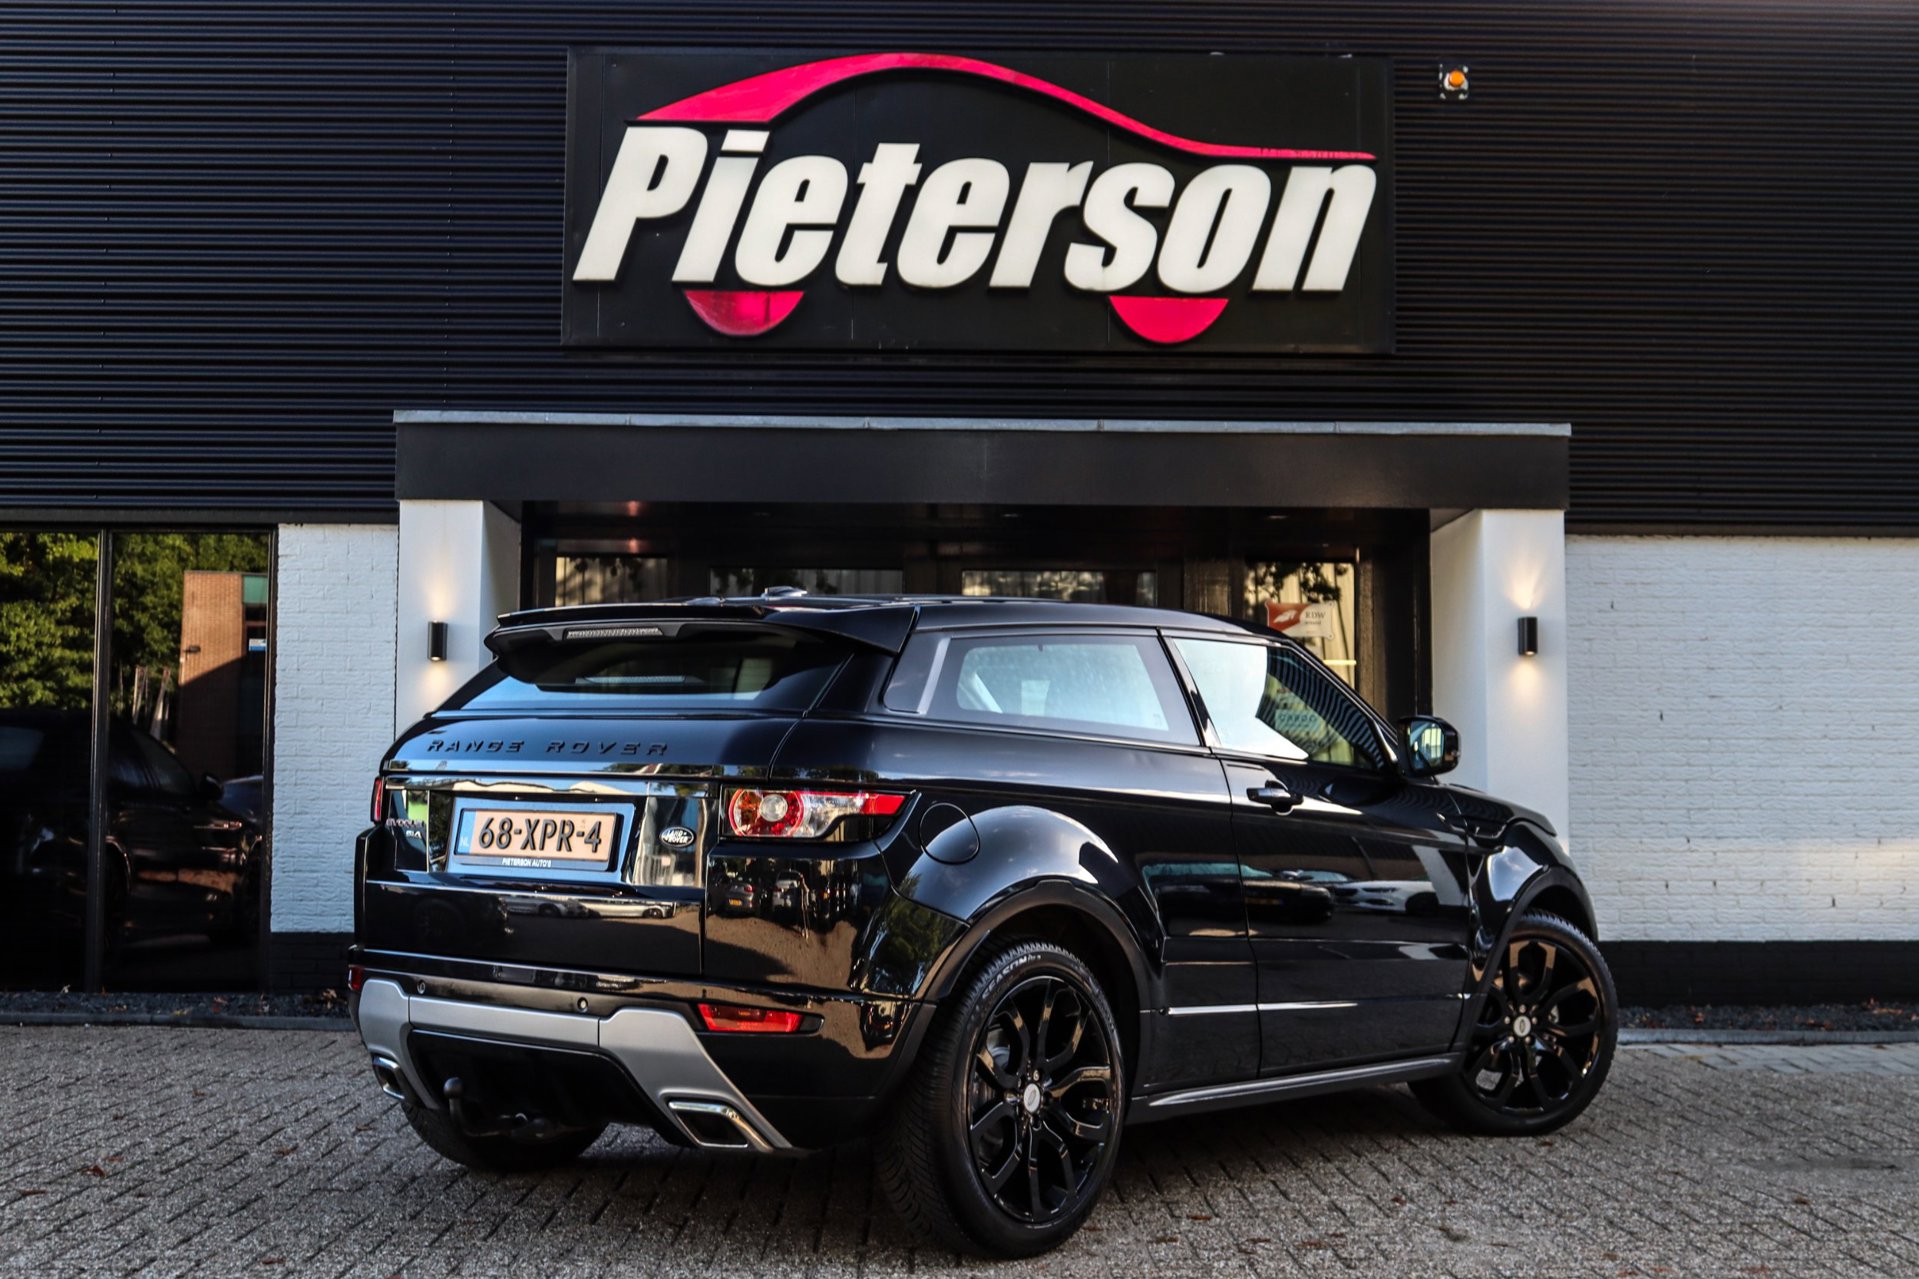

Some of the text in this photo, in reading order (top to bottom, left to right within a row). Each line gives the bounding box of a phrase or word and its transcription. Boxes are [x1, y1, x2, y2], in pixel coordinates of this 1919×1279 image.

[573, 126, 1377, 293] Pieterson
[427, 739, 668, 756] RANGE ROVER
[459, 836, 470, 847] NL
[478, 817, 602, 853] 68-XPR-4
